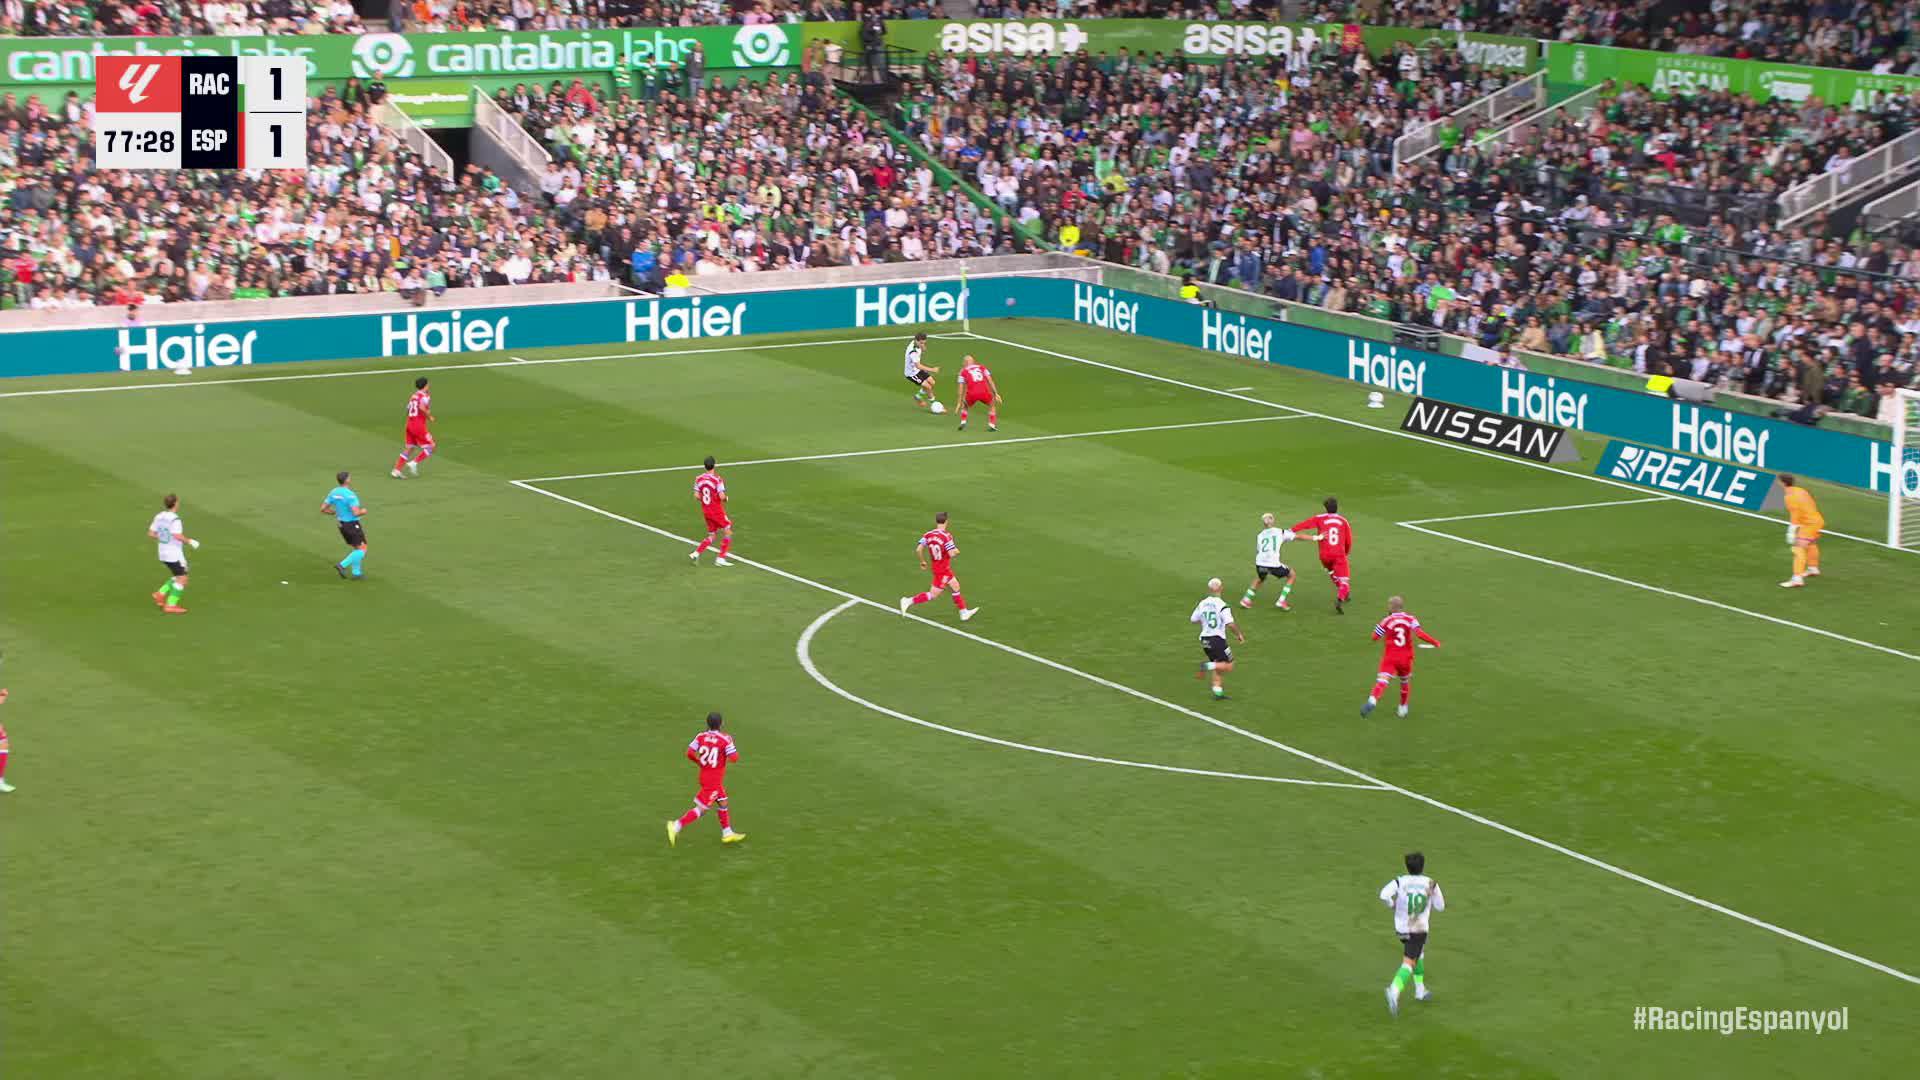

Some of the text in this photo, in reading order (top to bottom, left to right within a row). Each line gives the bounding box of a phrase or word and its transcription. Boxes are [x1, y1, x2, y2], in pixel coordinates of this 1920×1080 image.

[427, 30, 697, 73] cantabria labs
[941, 22, 1056, 53] asisa
[1184, 23, 1294, 56] asisa
[626, 297, 747, 342] Haier
[856, 282, 967, 327] Haier
[1074, 284, 1139, 334] Haier
[119, 324, 257, 371] Haier
[381, 310, 510, 357] Haier
[1202, 310, 1272, 361] Haier
[1349, 339, 1426, 395] Haier
[1502, 370, 1588, 431] Haier
[1407, 402, 1558, 458] NISSAN
[1672, 403, 1769, 467] Haier
[702, 487, 711, 505] 8
[1636, 450, 1757, 505] REALE
[1261, 535, 1277, 553] 21
[1328, 527, 1339, 546] 6
[1201, 611, 1217, 629] 15
[1393, 627, 1406, 647] 3
[699, 745, 719, 768] 24
